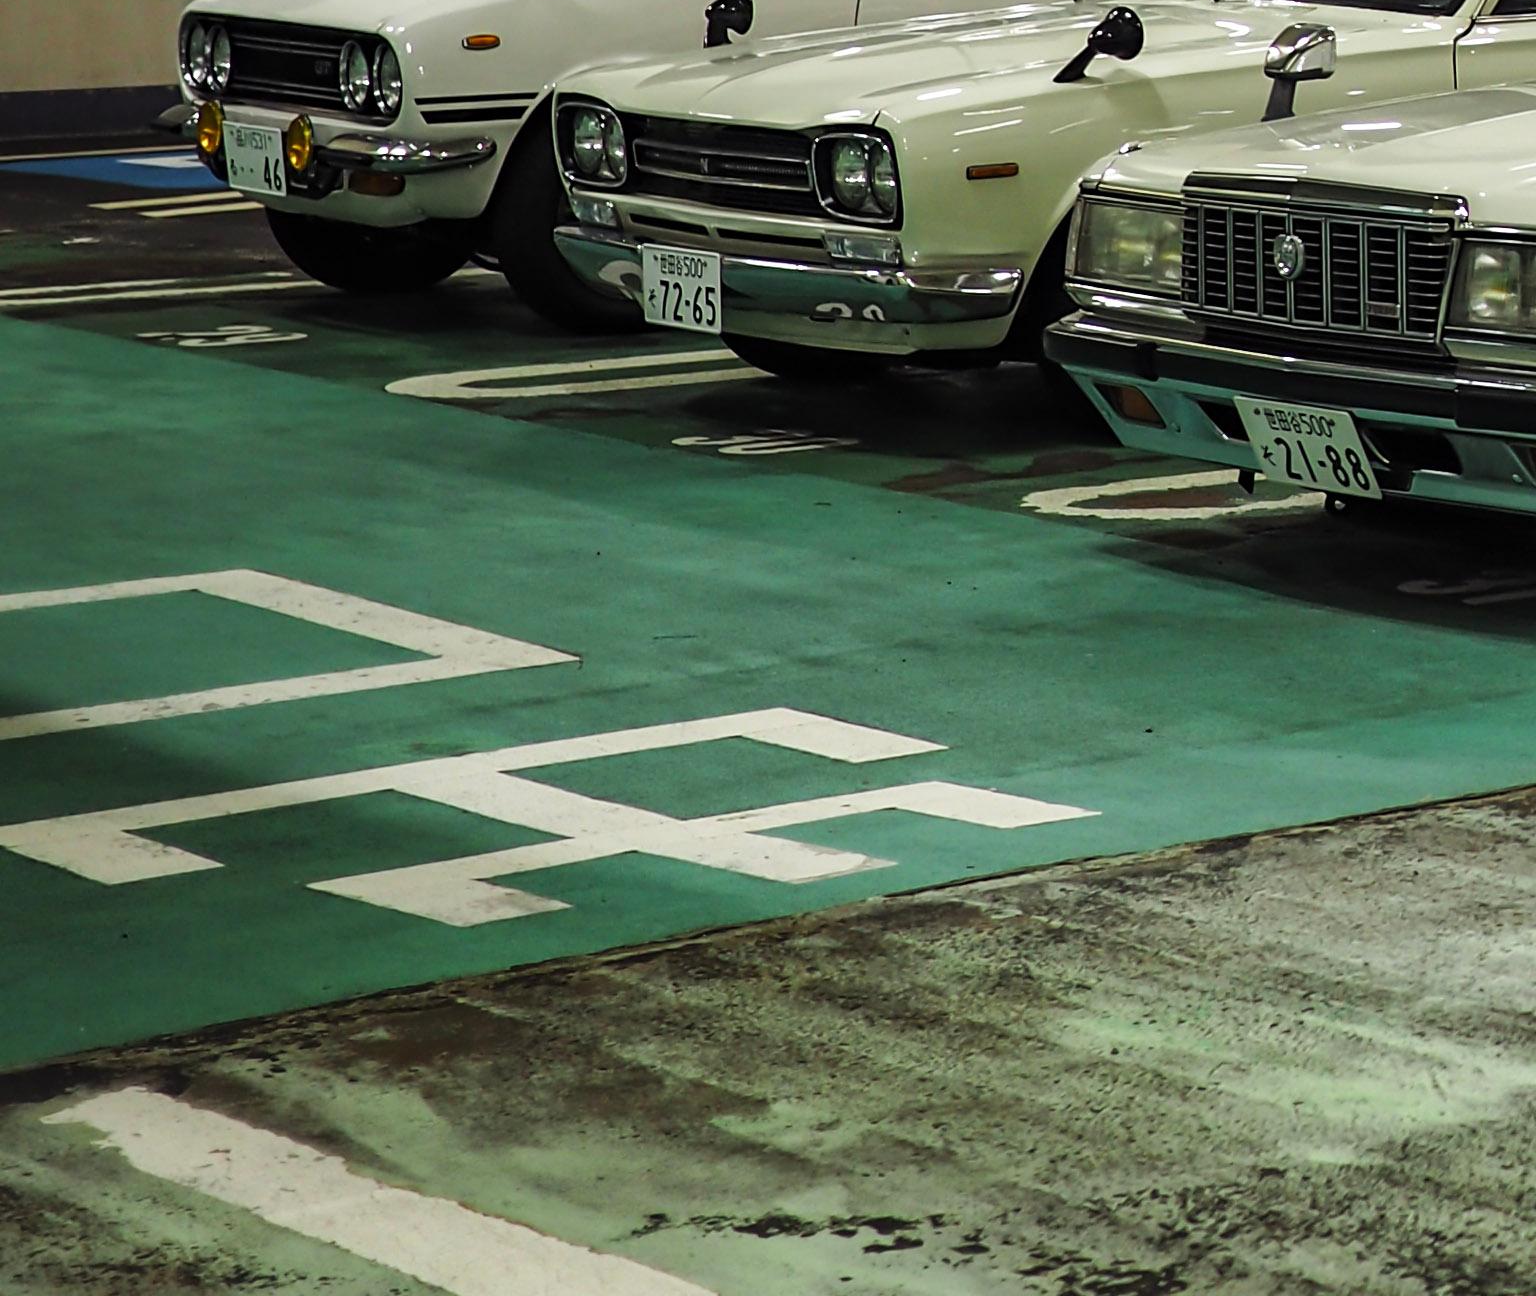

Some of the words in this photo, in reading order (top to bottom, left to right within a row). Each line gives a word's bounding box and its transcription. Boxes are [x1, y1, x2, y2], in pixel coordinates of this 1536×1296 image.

[660, 280, 716, 326] 72-65
[1263, 407, 1333, 438] 世田谷500
[1273, 437, 1371, 491] 21-88
